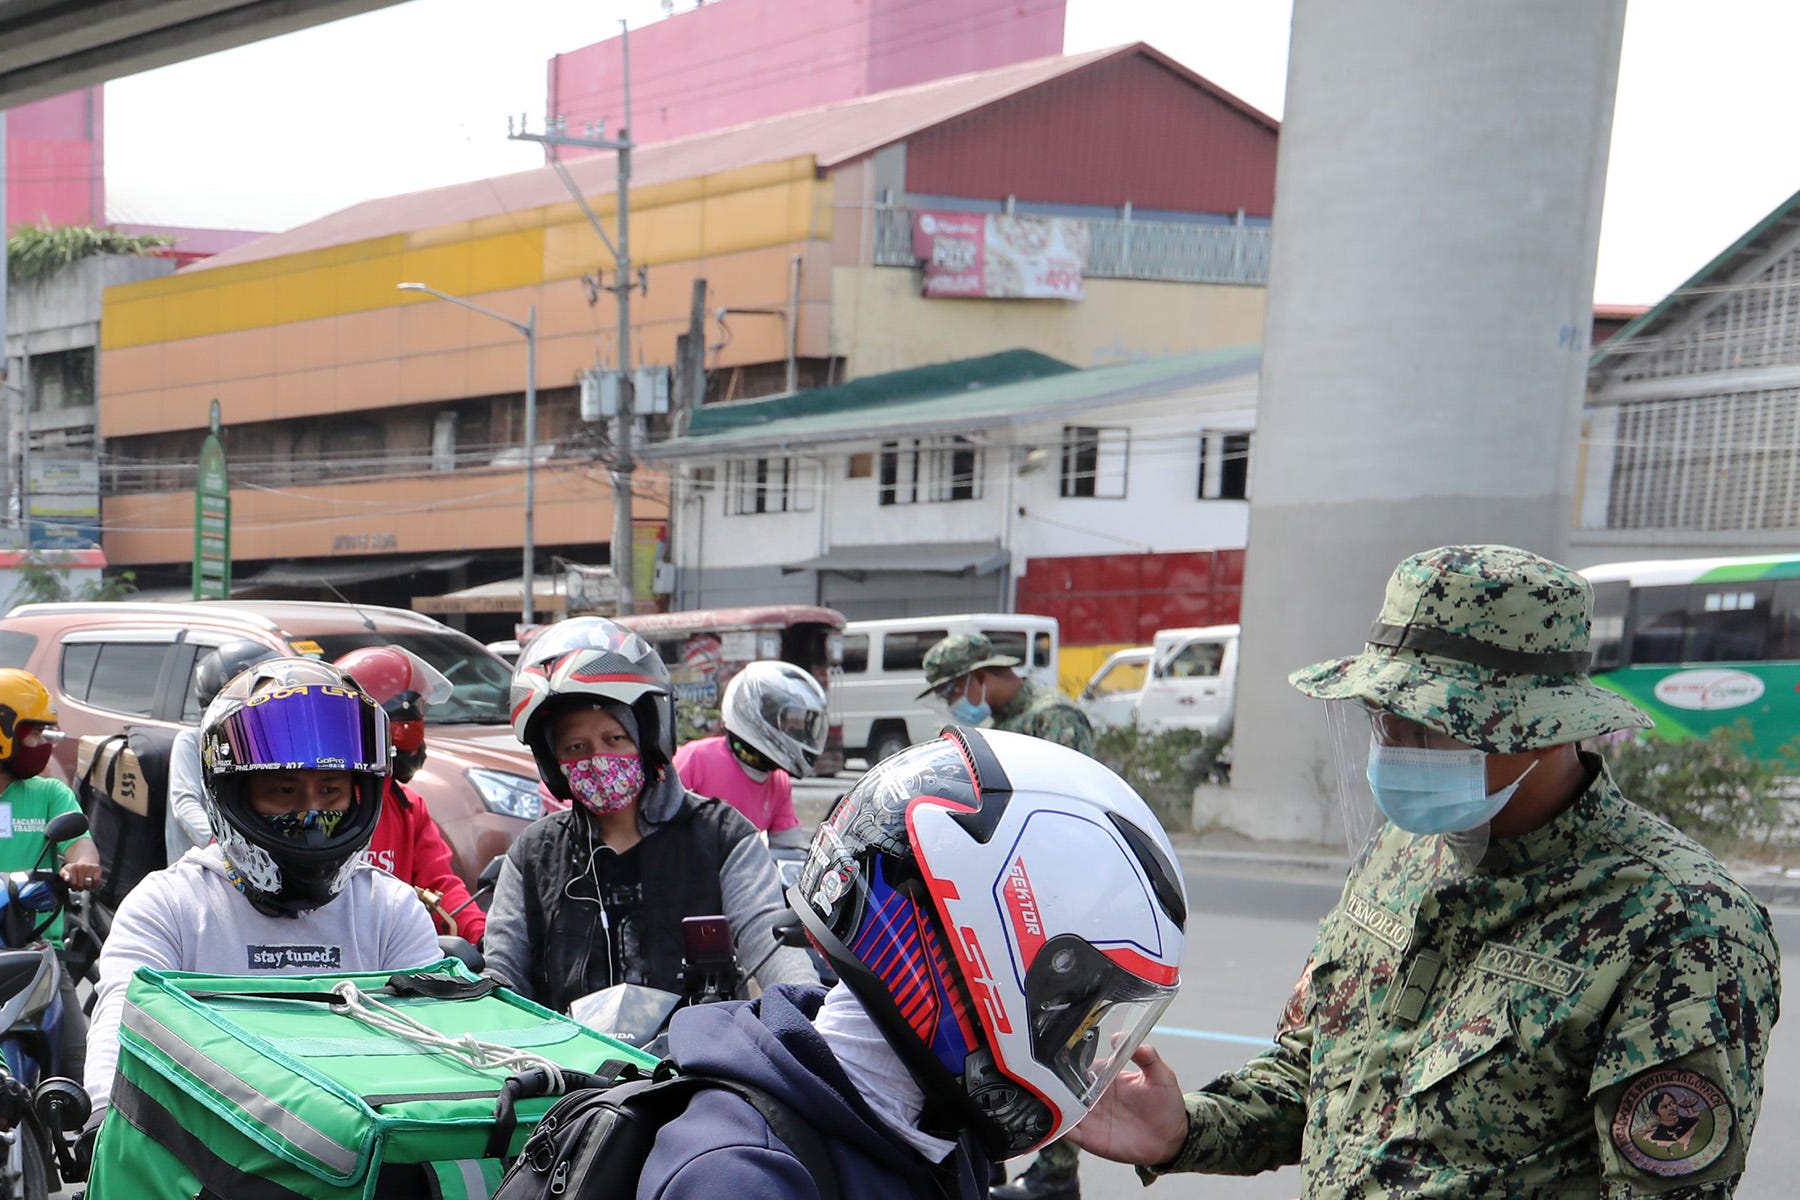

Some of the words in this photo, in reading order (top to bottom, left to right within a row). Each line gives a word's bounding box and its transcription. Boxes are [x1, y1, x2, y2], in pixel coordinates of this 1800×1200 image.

[1348, 898, 1408, 944] TENORIO
[254, 951, 287, 965] stay
[286, 949, 335, 963] tuned.
[1486, 947, 1573, 988] POLICE
